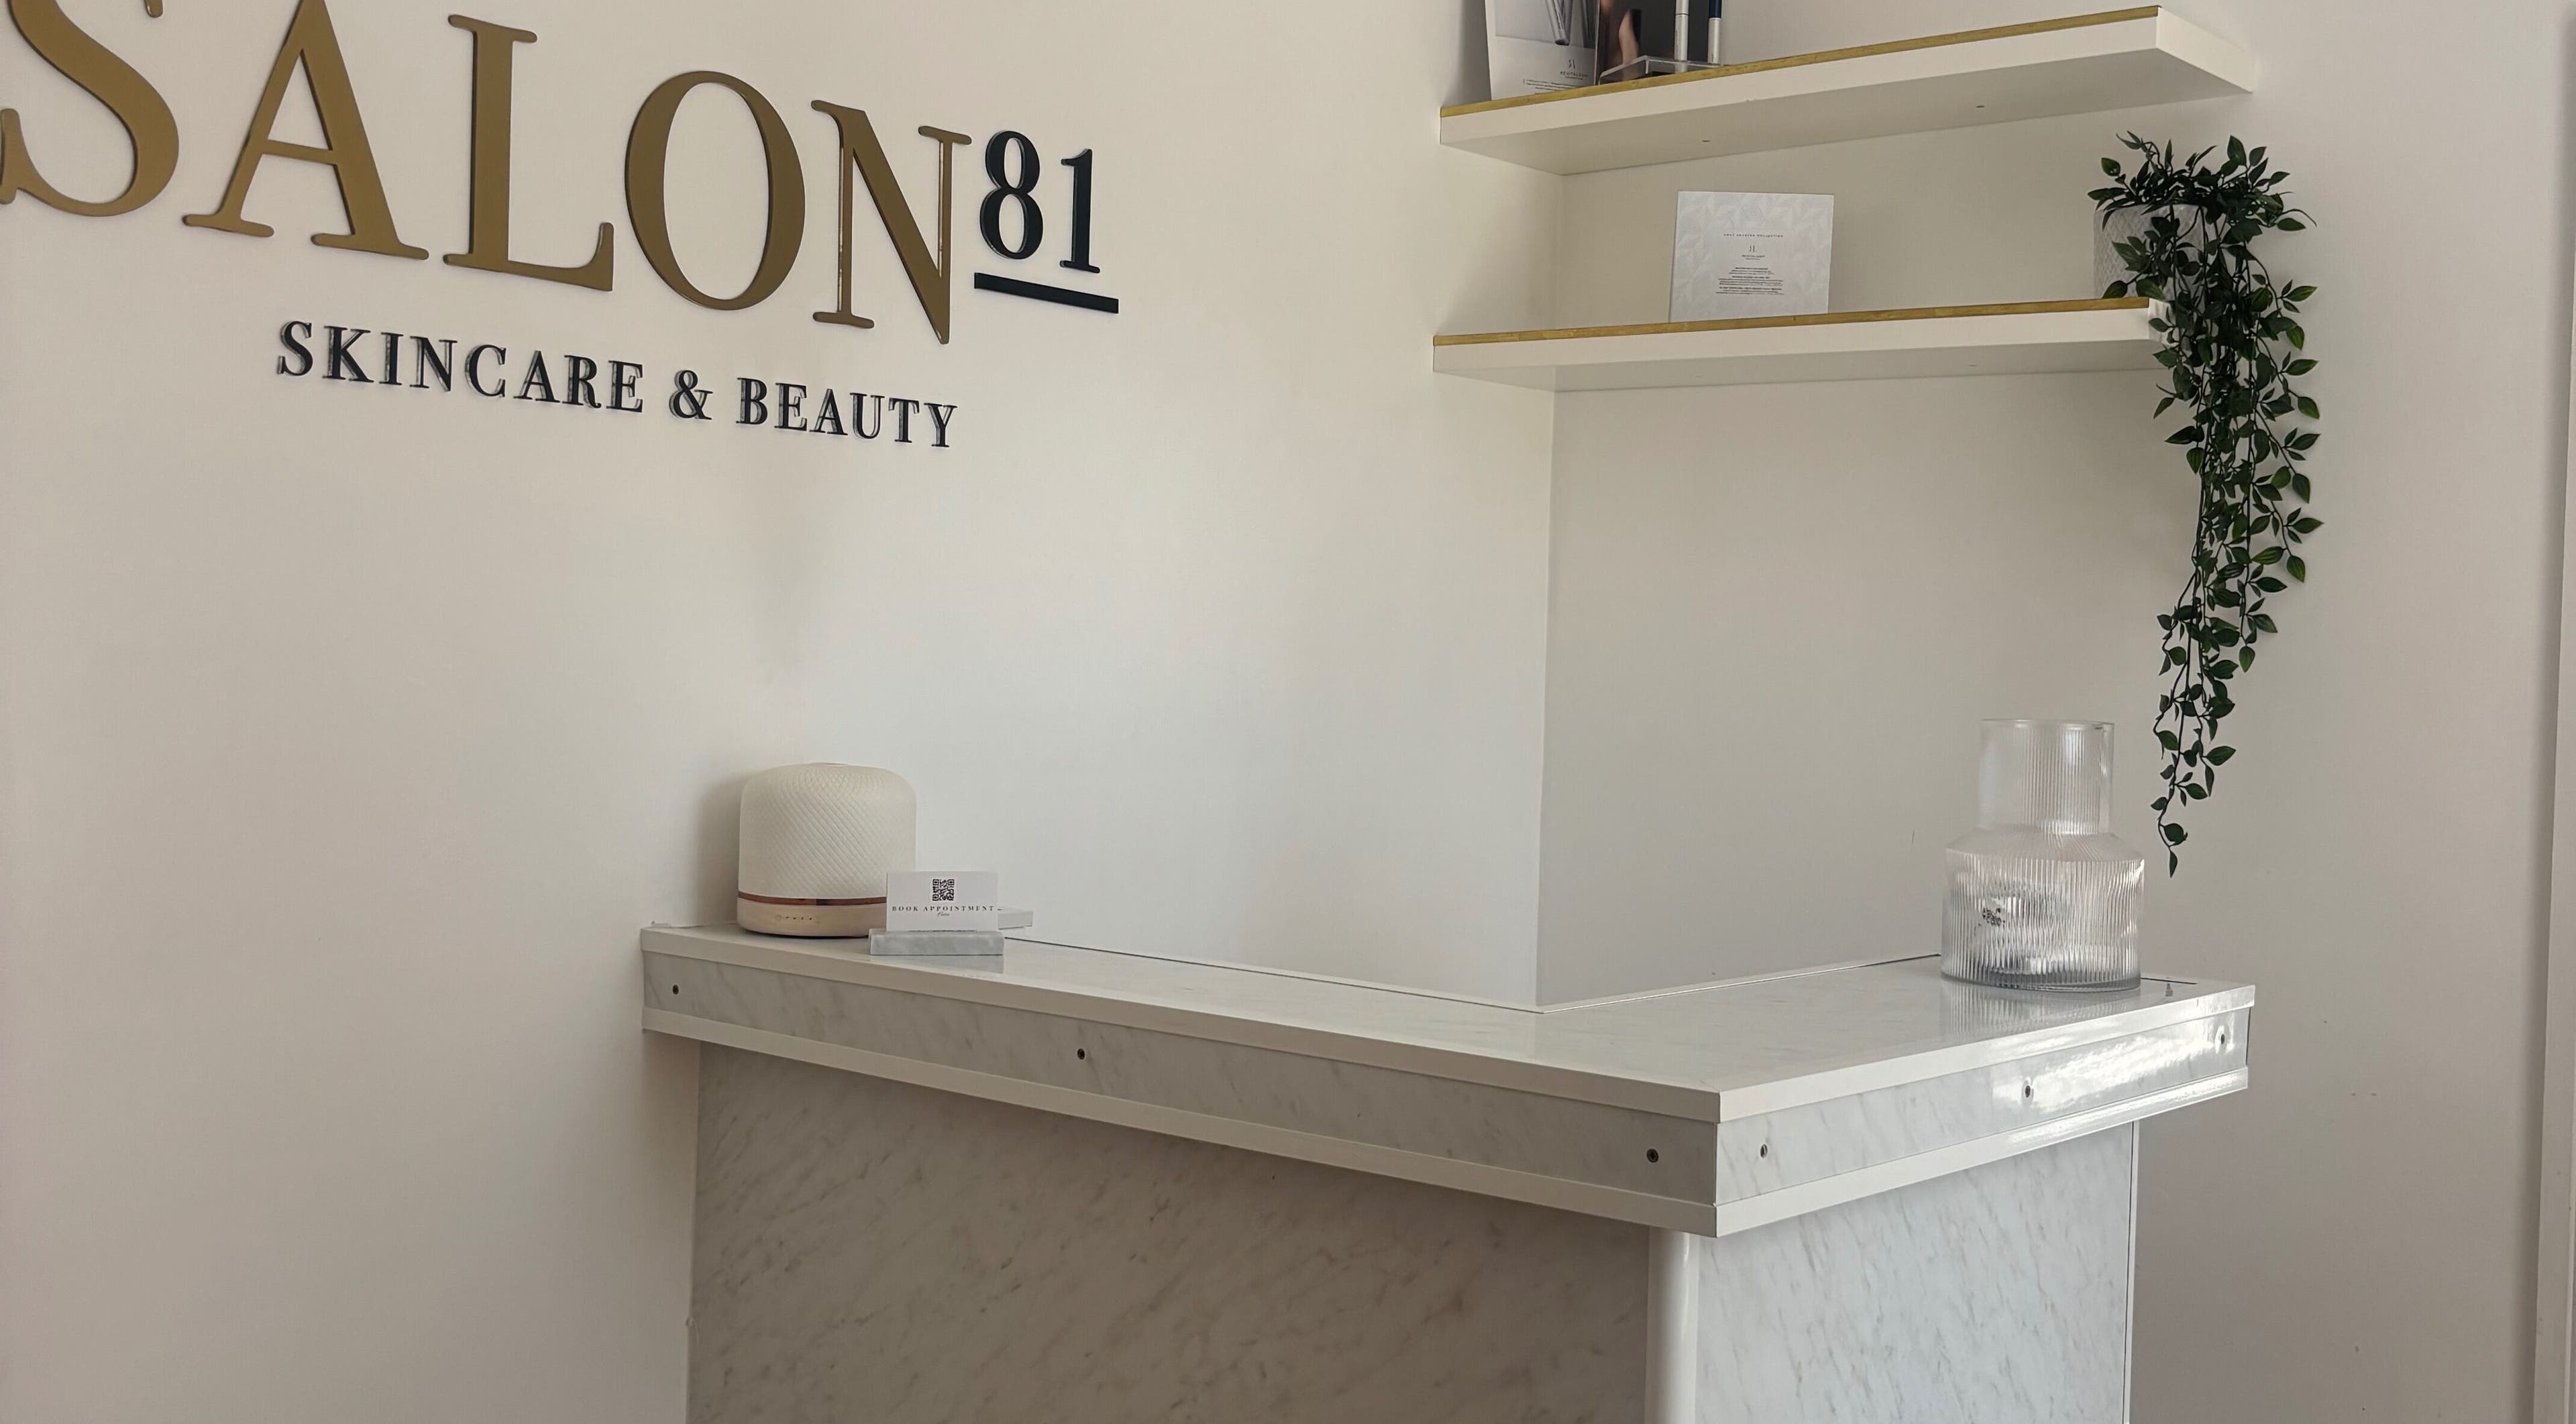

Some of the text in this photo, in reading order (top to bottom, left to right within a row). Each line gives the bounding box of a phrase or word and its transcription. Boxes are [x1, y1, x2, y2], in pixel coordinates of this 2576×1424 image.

[0, 0, 1101, 345] SALON 81
[276, 321, 958, 448] SKINCARE & BEAUTY
